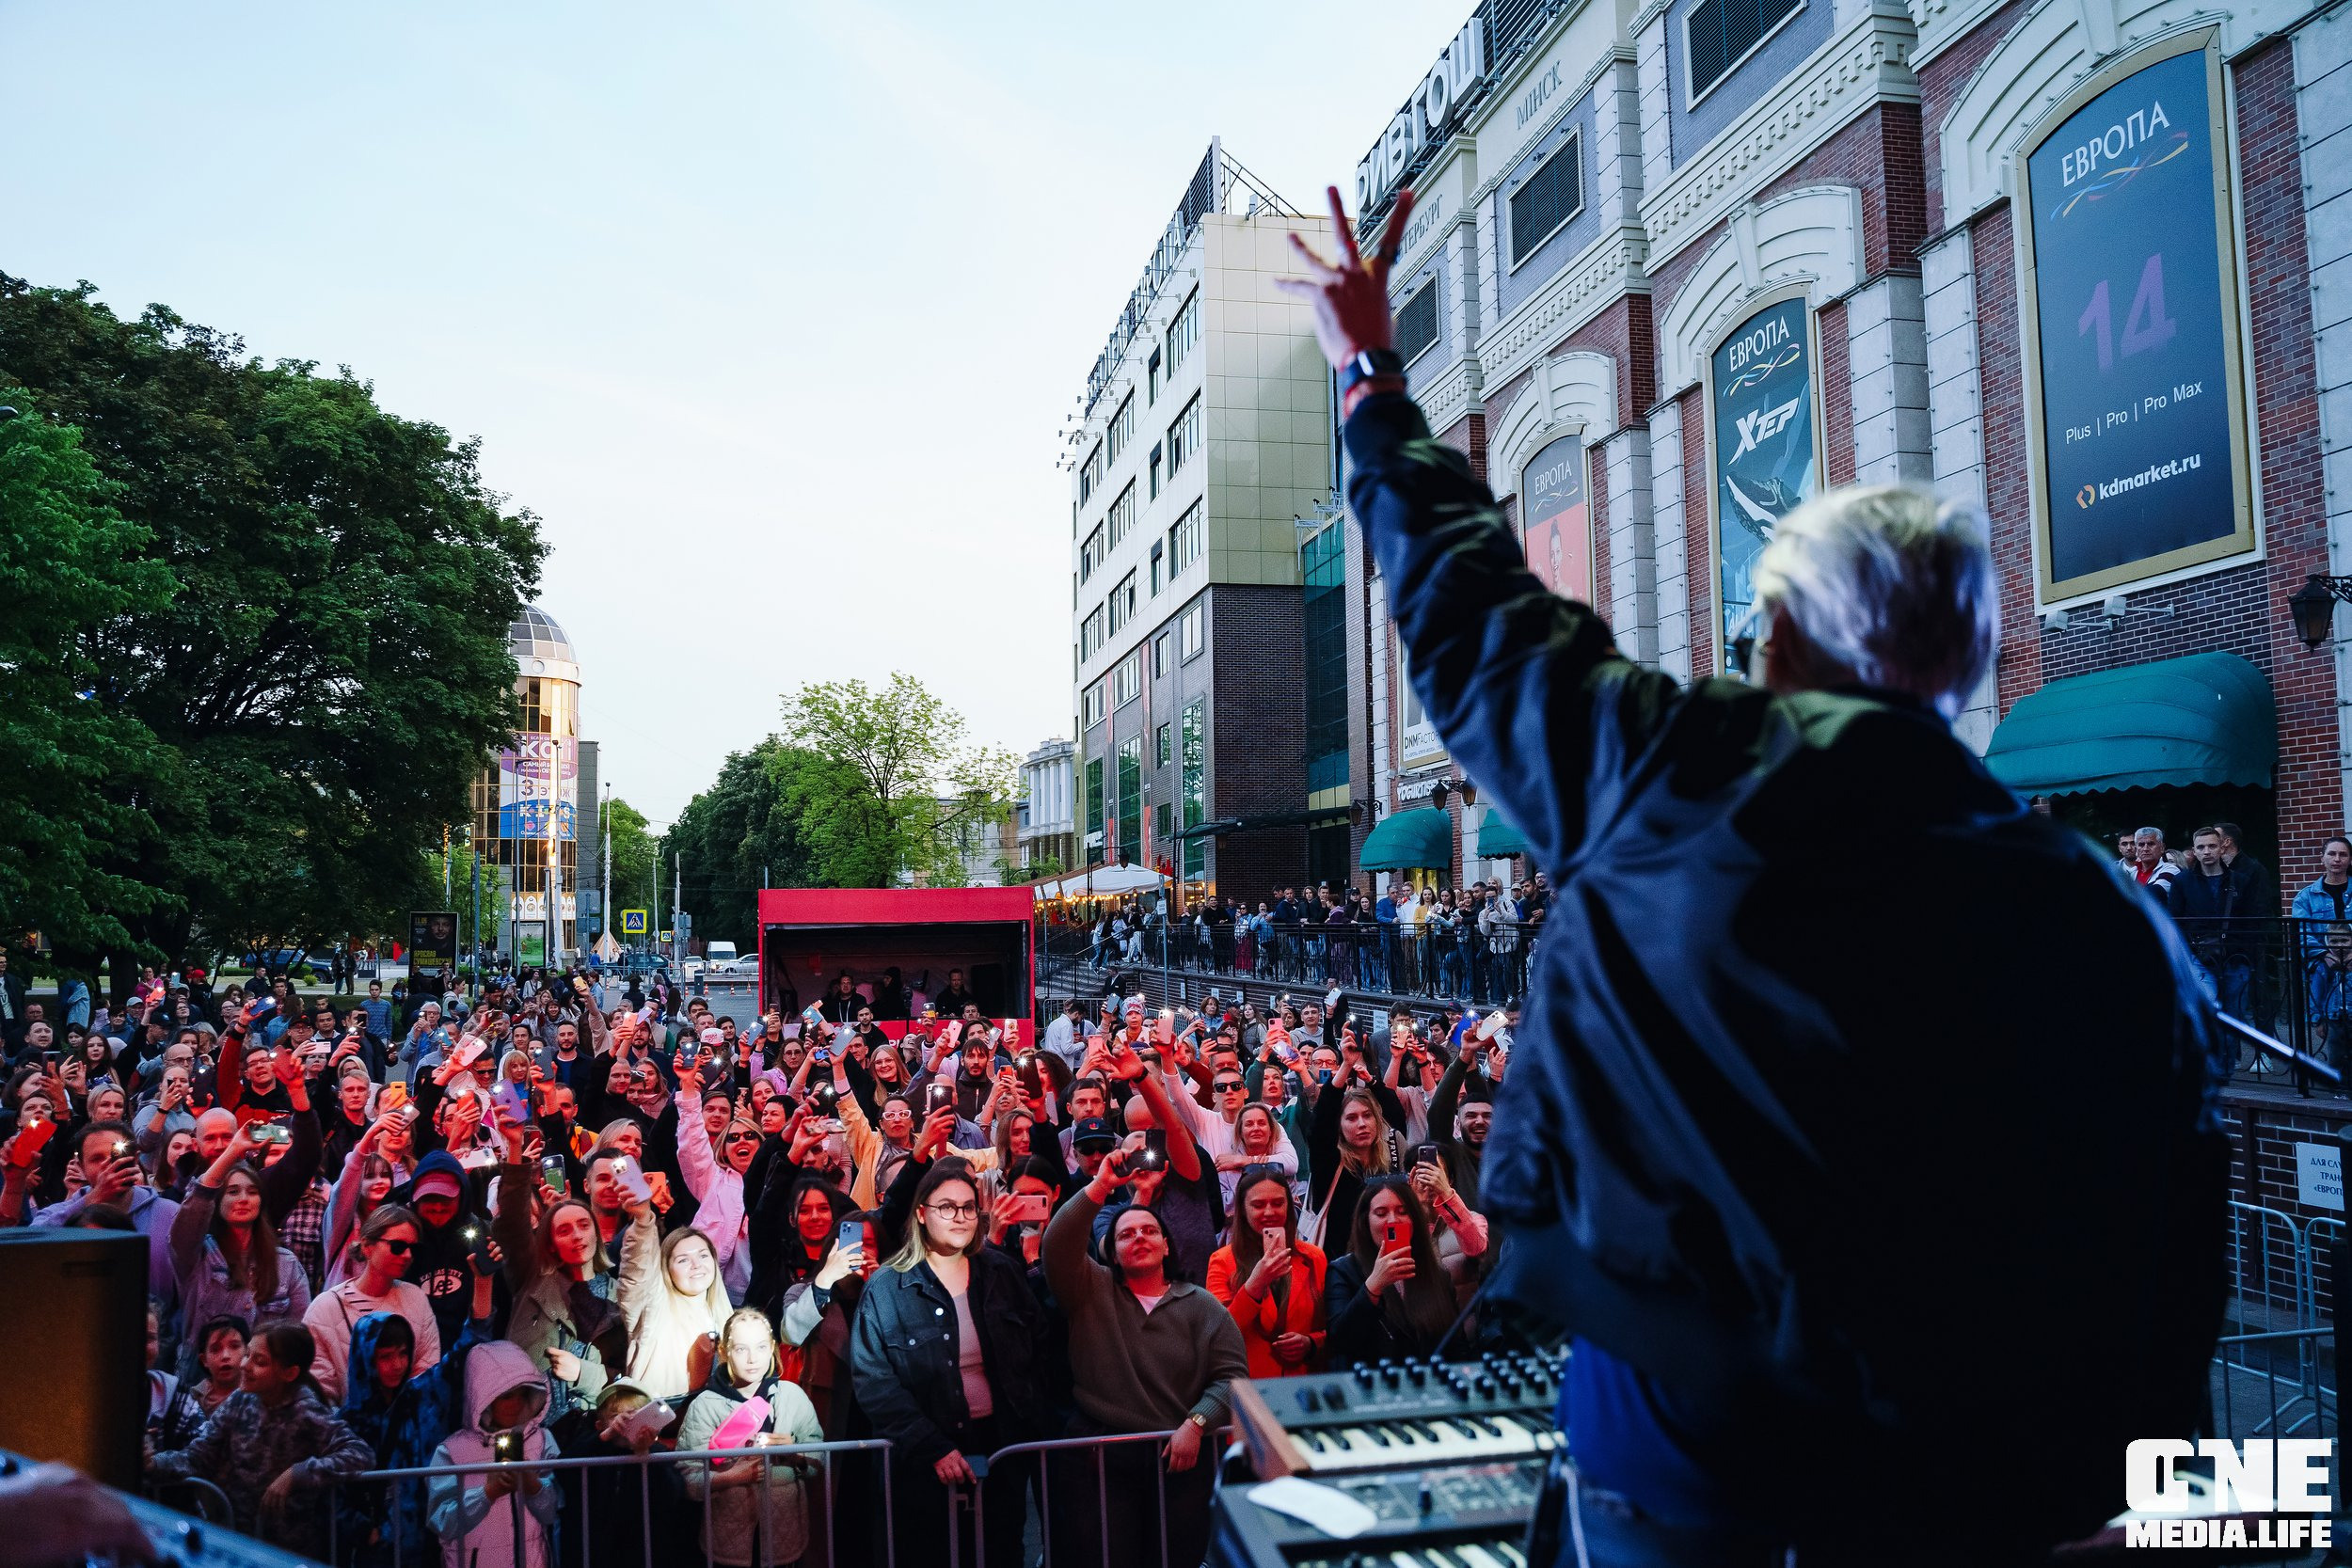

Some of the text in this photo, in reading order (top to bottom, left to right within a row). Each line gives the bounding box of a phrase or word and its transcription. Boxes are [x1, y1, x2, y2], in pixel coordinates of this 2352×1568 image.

[2061, 100, 2169, 188] ЕВРОПА
[2078, 252, 2176, 373] 14
[1729, 315, 1790, 372] ЕВРОПА
[2065, 379, 2203, 445] Plus Pro Pro Max
[1534, 461, 1573, 497] ЕВРОПА
[2099, 452, 2201, 500] kdmarket.ru
[520, 779, 534, 797] 3
[2314, 1184, 2344, 1196] «ЕВРОП
[2320, 1171, 2343, 1182] ТРАН
